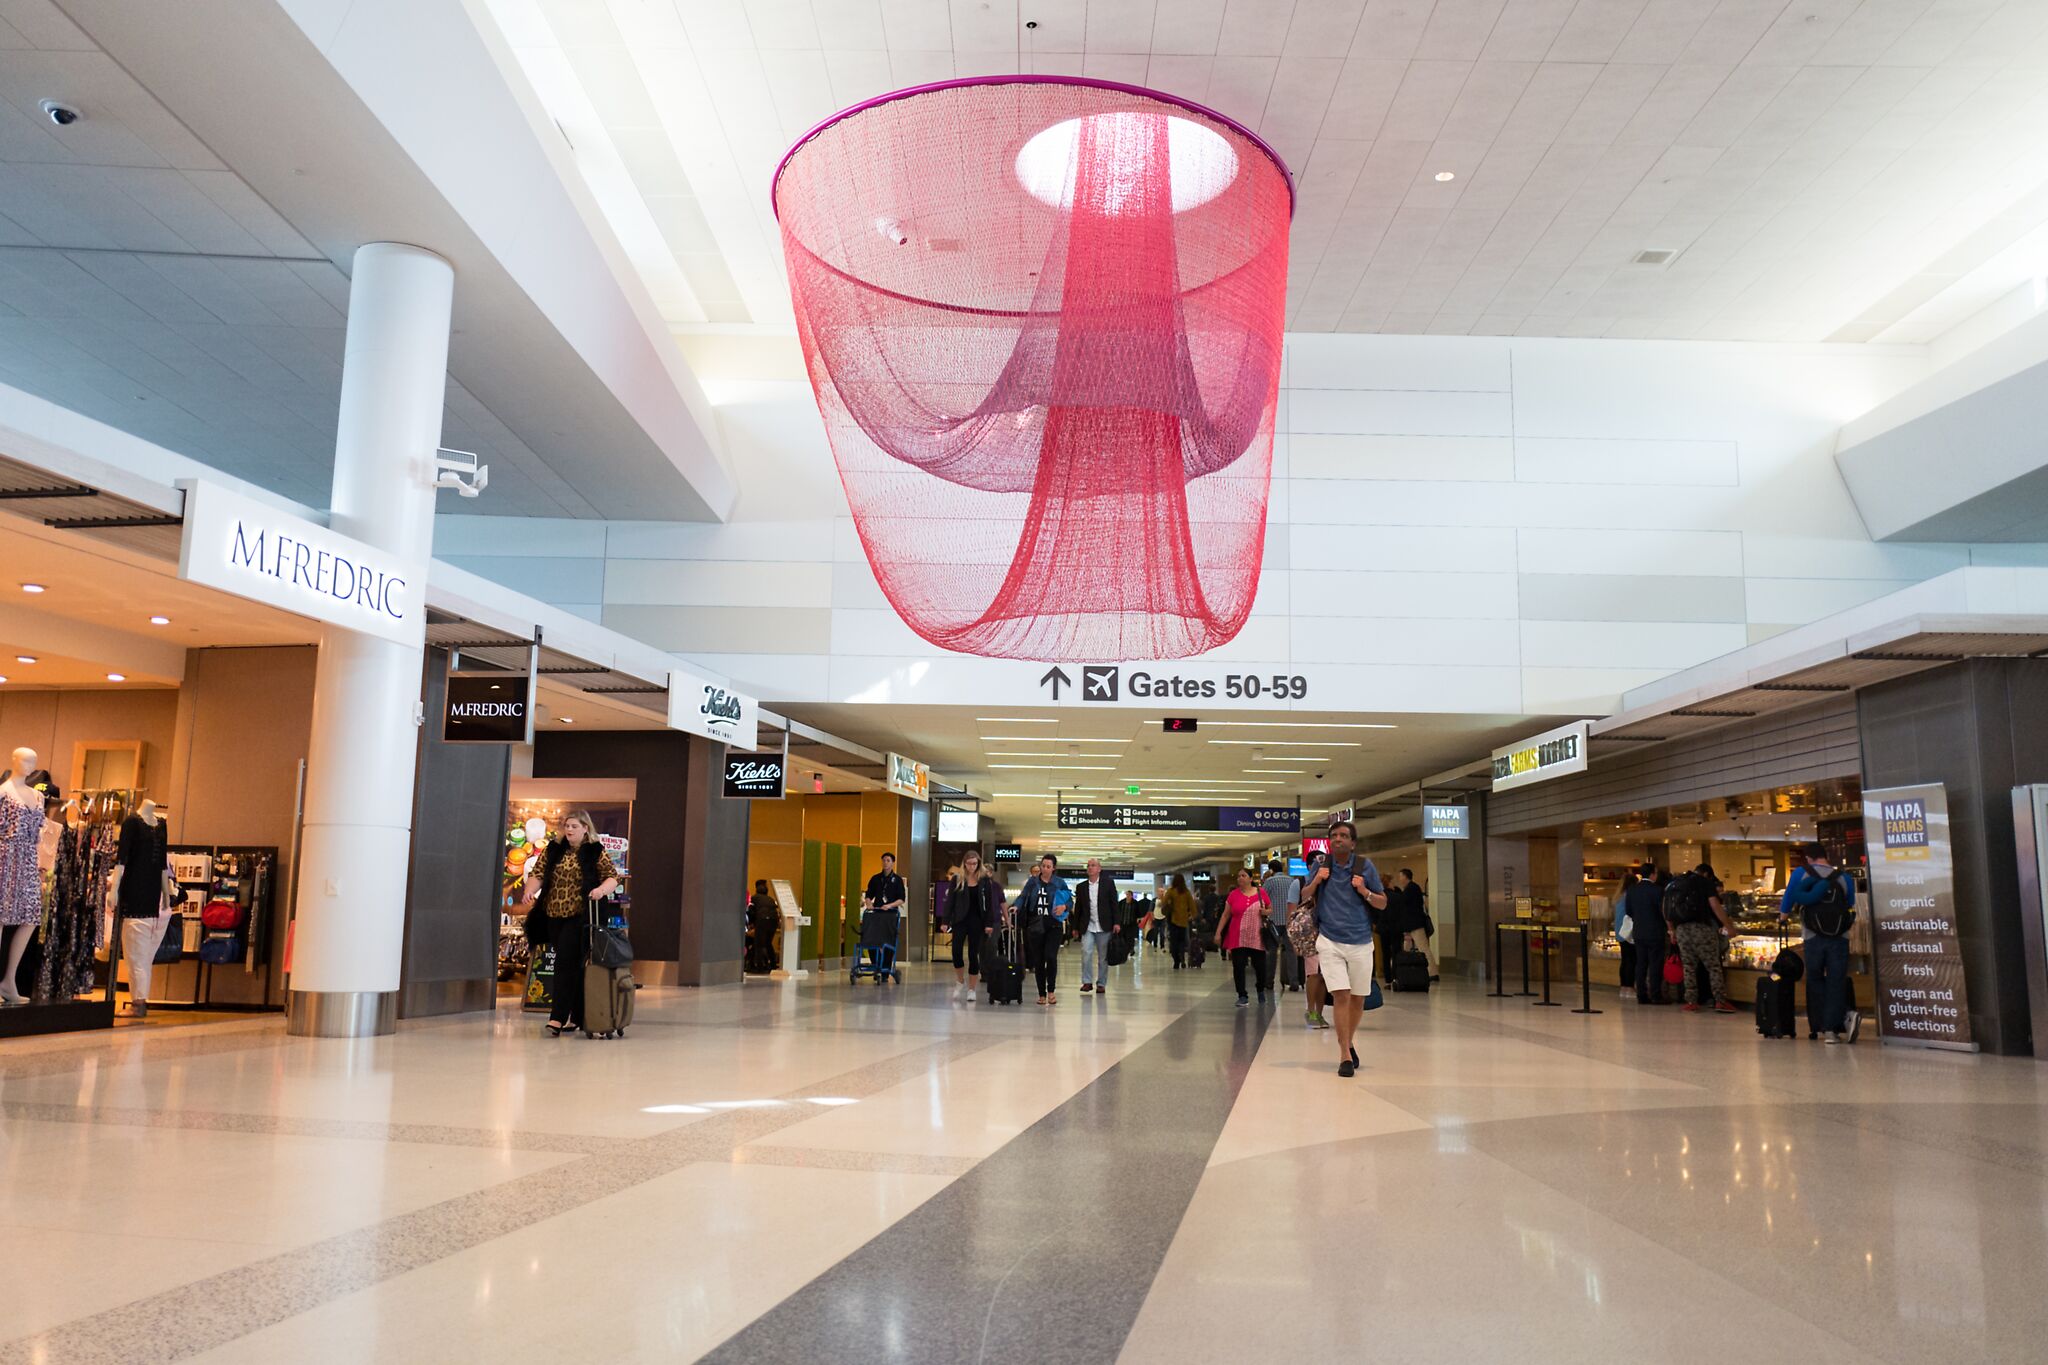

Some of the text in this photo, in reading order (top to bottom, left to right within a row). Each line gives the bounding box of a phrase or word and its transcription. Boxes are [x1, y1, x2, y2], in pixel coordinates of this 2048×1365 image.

[232, 520, 406, 618] M.FREDRIC
[1128, 671, 1307, 699] Gates 50-59
[451, 702, 523, 717] M.FREDRIC
[700, 685, 741, 721] Kiehl's
[1512, 748, 1537, 774] FARMS
[1538, 734, 1578, 767] MARKET
[725, 762, 781, 780] Kiehl's
[1432, 809, 1460, 819] NAPA
[1884, 802, 1922, 820] NAPA
[1078, 817, 1110, 825] Shoeshine
[1132, 818, 1150, 826] Flight
[1236, 820, 1256, 829] Dining
[1262, 821, 1290, 829] Shopping
[1432, 819, 1460, 827] FARMS
[1886, 819, 1924, 833] FARMS
[1887, 832, 1925, 844] MARKET
[1896, 872, 1924, 885] local
[1889, 896, 1935, 910] organic
[1881, 918, 1949, 931] sustainable
[1891, 941, 1943, 953] artisanal
[1903, 964, 1934, 976] fresh
[1889, 988, 1953, 1001] vegan and
[1888, 1002, 1958, 1017] gluten-free
[1893, 1018, 1956, 1033] selections
